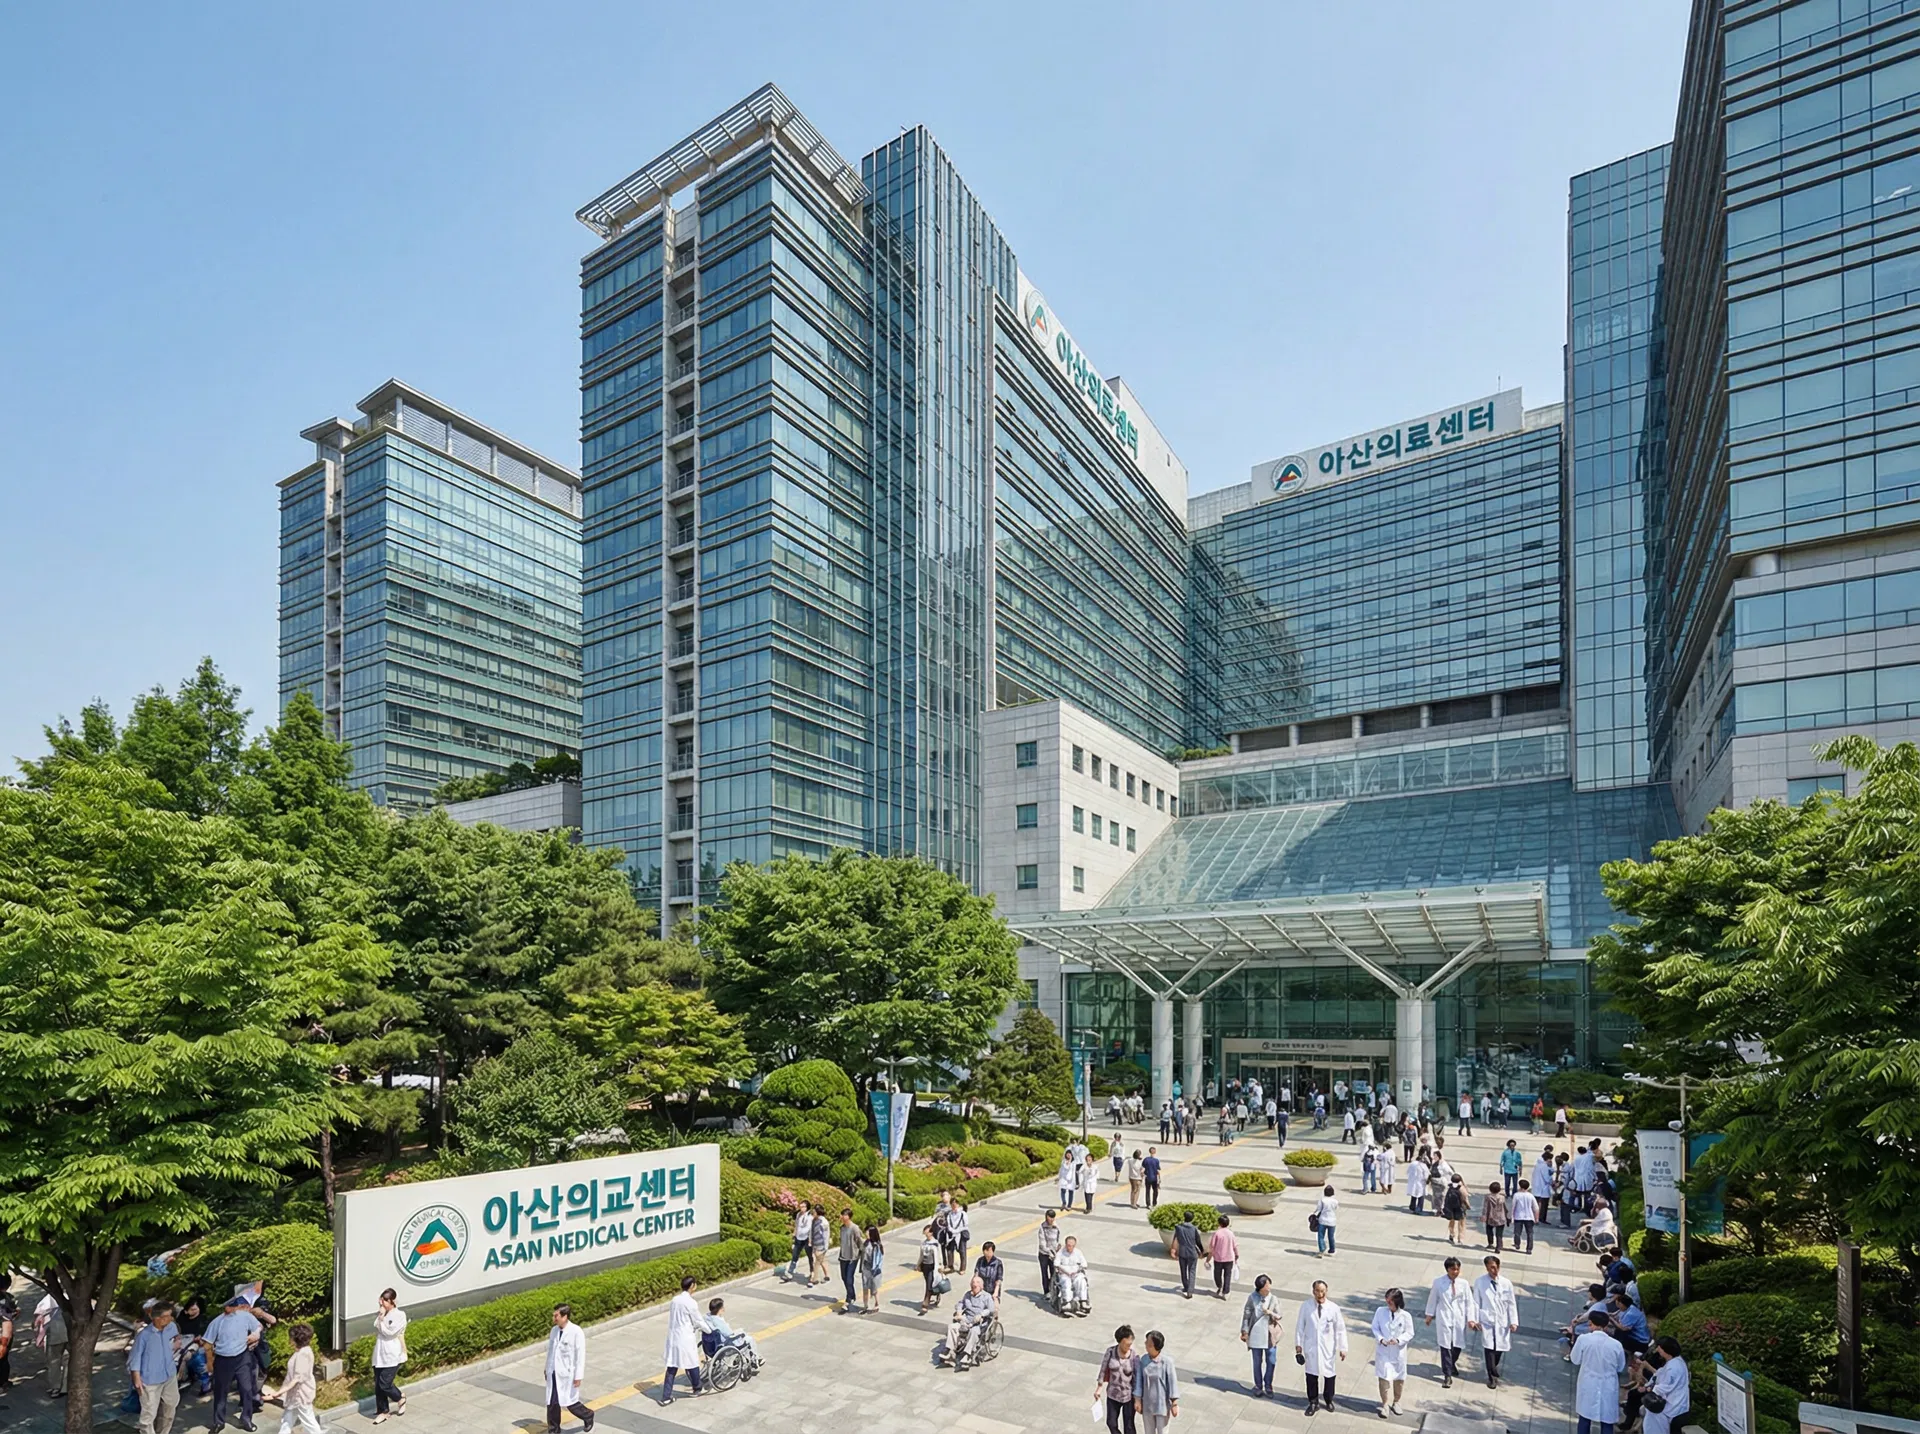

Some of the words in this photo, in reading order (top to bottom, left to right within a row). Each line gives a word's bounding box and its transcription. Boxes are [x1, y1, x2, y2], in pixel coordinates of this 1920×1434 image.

[1056, 332, 1138, 460] 아산의료센터
[1318, 401, 1495, 475] 아산의료센터
[483, 1163, 696, 1238] 아산의교센터
[484, 1238, 542, 1271] ASAN
[549, 1222, 629, 1257] NEDICAL
[632, 1208, 696, 1238] CENTER
